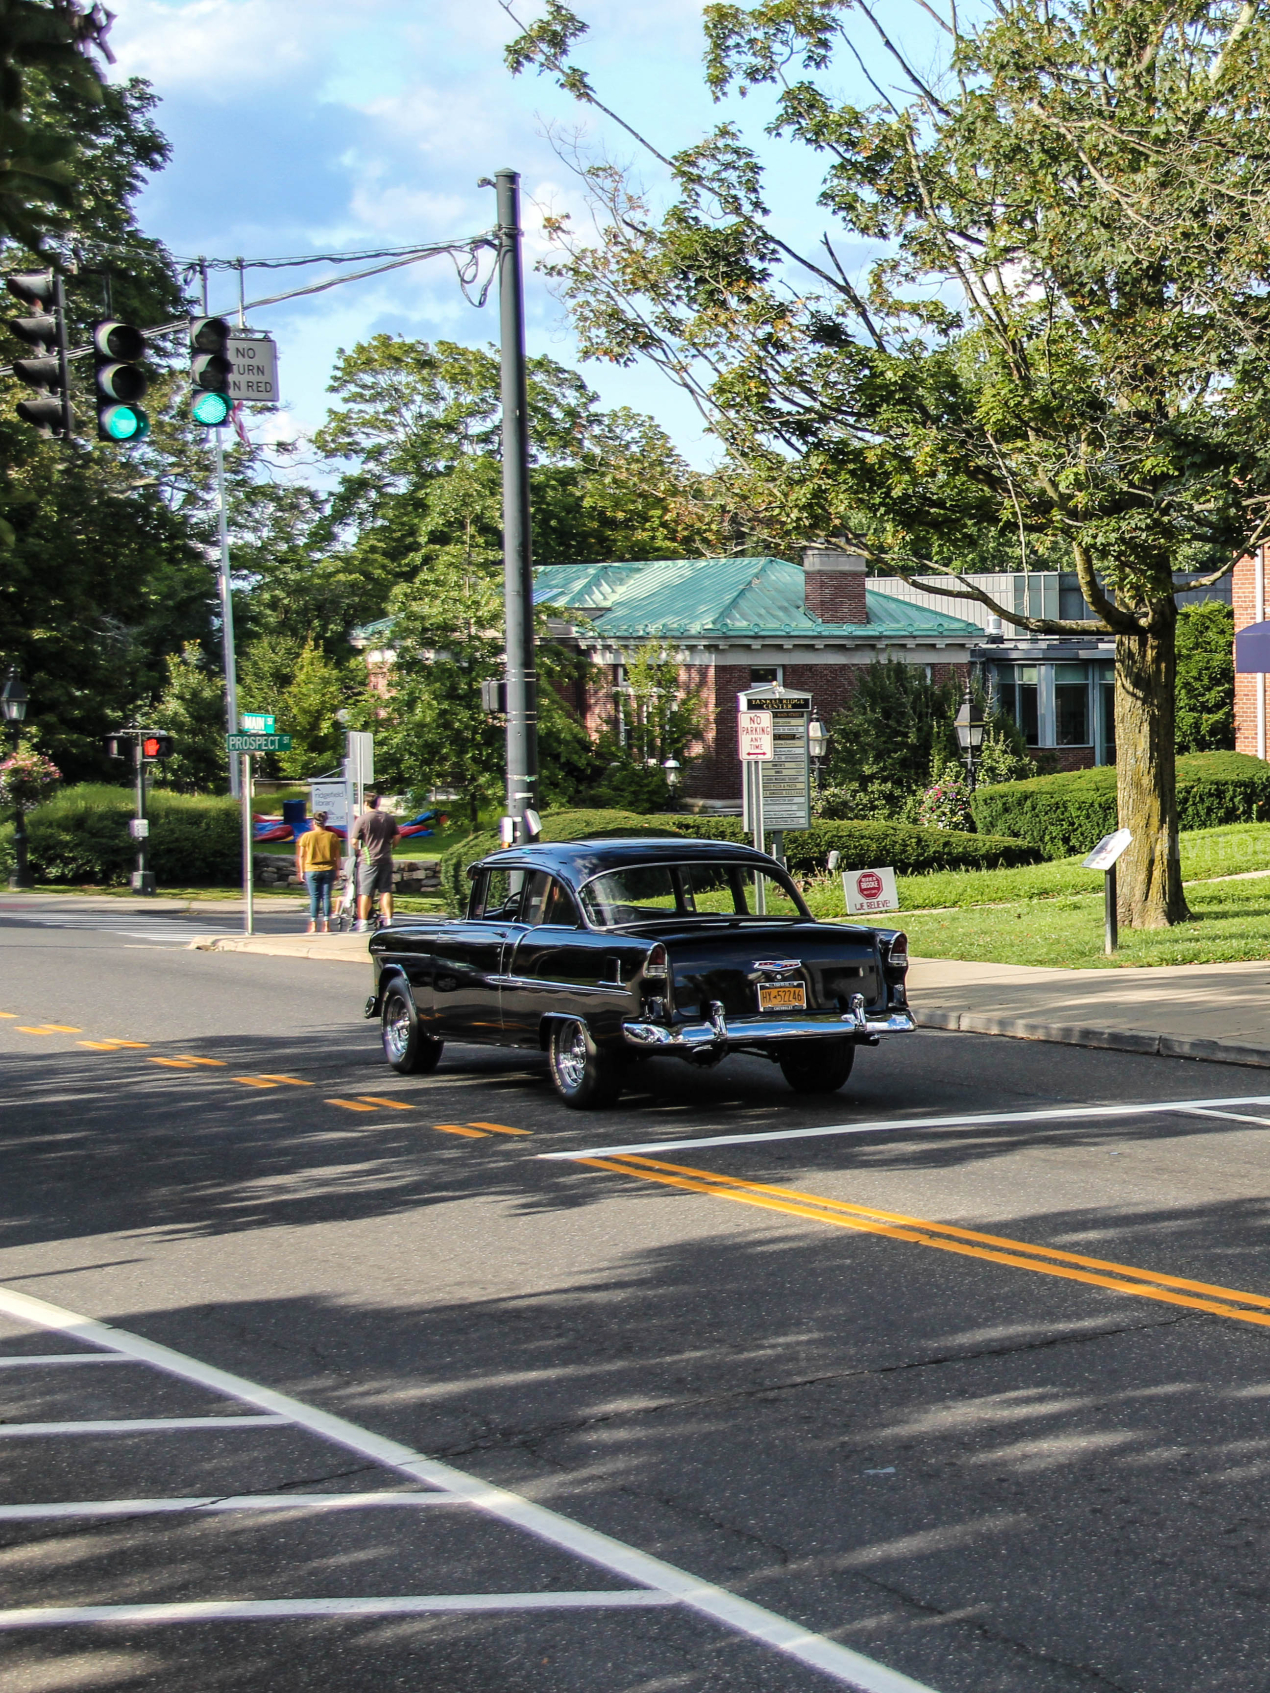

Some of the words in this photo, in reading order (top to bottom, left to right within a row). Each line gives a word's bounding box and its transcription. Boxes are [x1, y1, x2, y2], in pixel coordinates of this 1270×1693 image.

[235, 347, 256, 359] NO
[230, 363, 265, 376] TURN
[246, 380, 273, 393] RED
[244, 715, 265, 730] MAIN
[266, 717, 274, 725] ST
[749, 715, 762, 725] NO
[741, 726, 770, 736] PARKING
[229, 736, 280, 750] PROSPECT
[282, 736, 290, 744] ST
[314, 791, 344, 799] ridgefield
[315, 800, 335, 808] library
[854, 902, 866, 911] WE
[776, 989, 803, 1003] 52246
